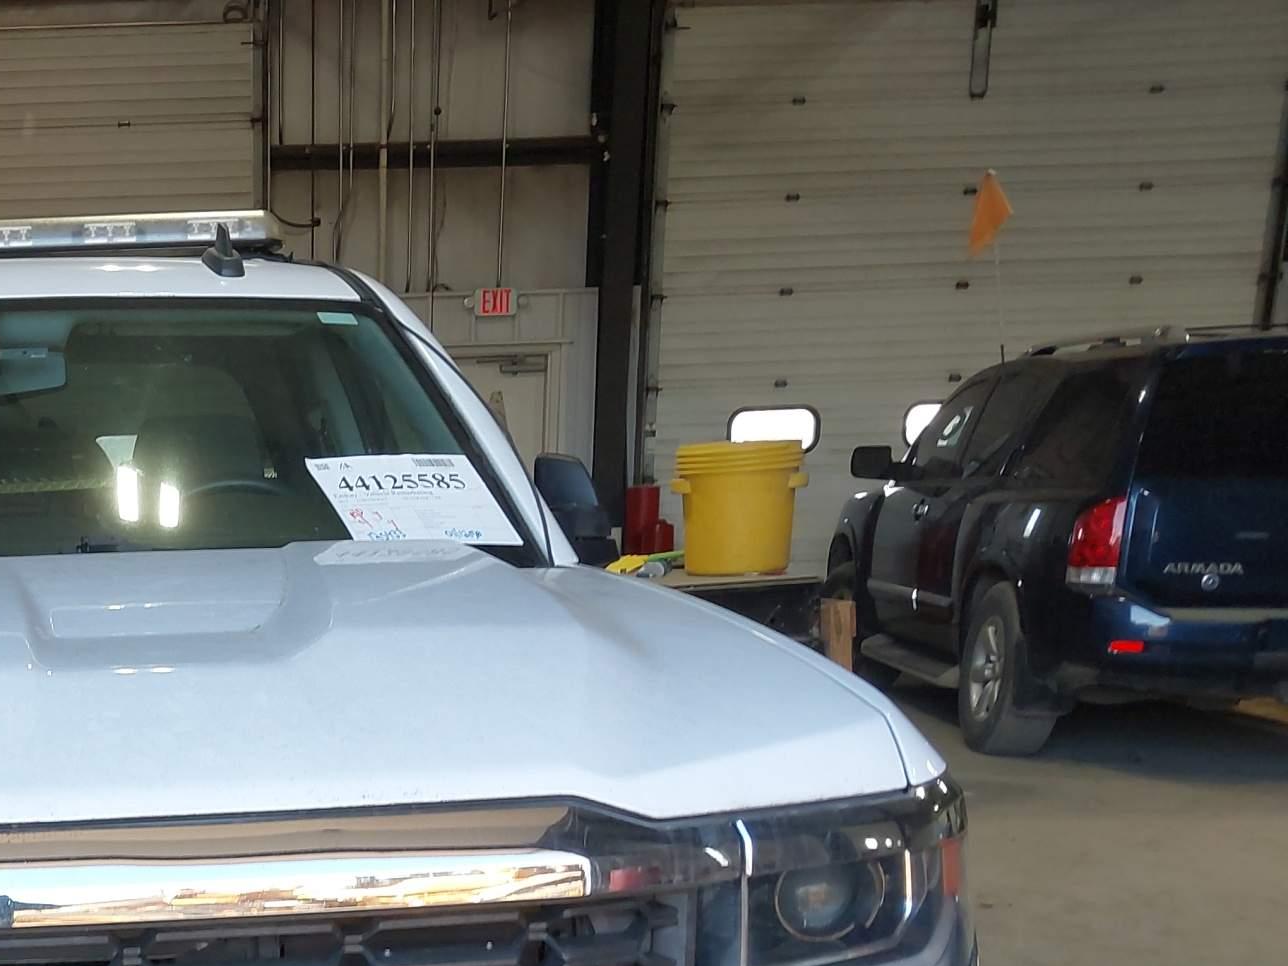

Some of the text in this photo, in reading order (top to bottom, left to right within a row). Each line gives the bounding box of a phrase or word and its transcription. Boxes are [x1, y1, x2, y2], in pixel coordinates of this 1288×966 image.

[482, 289, 511, 314] EXIT
[338, 473, 466, 492] 44125585
[1163, 562, 1244, 575] ARMADA
